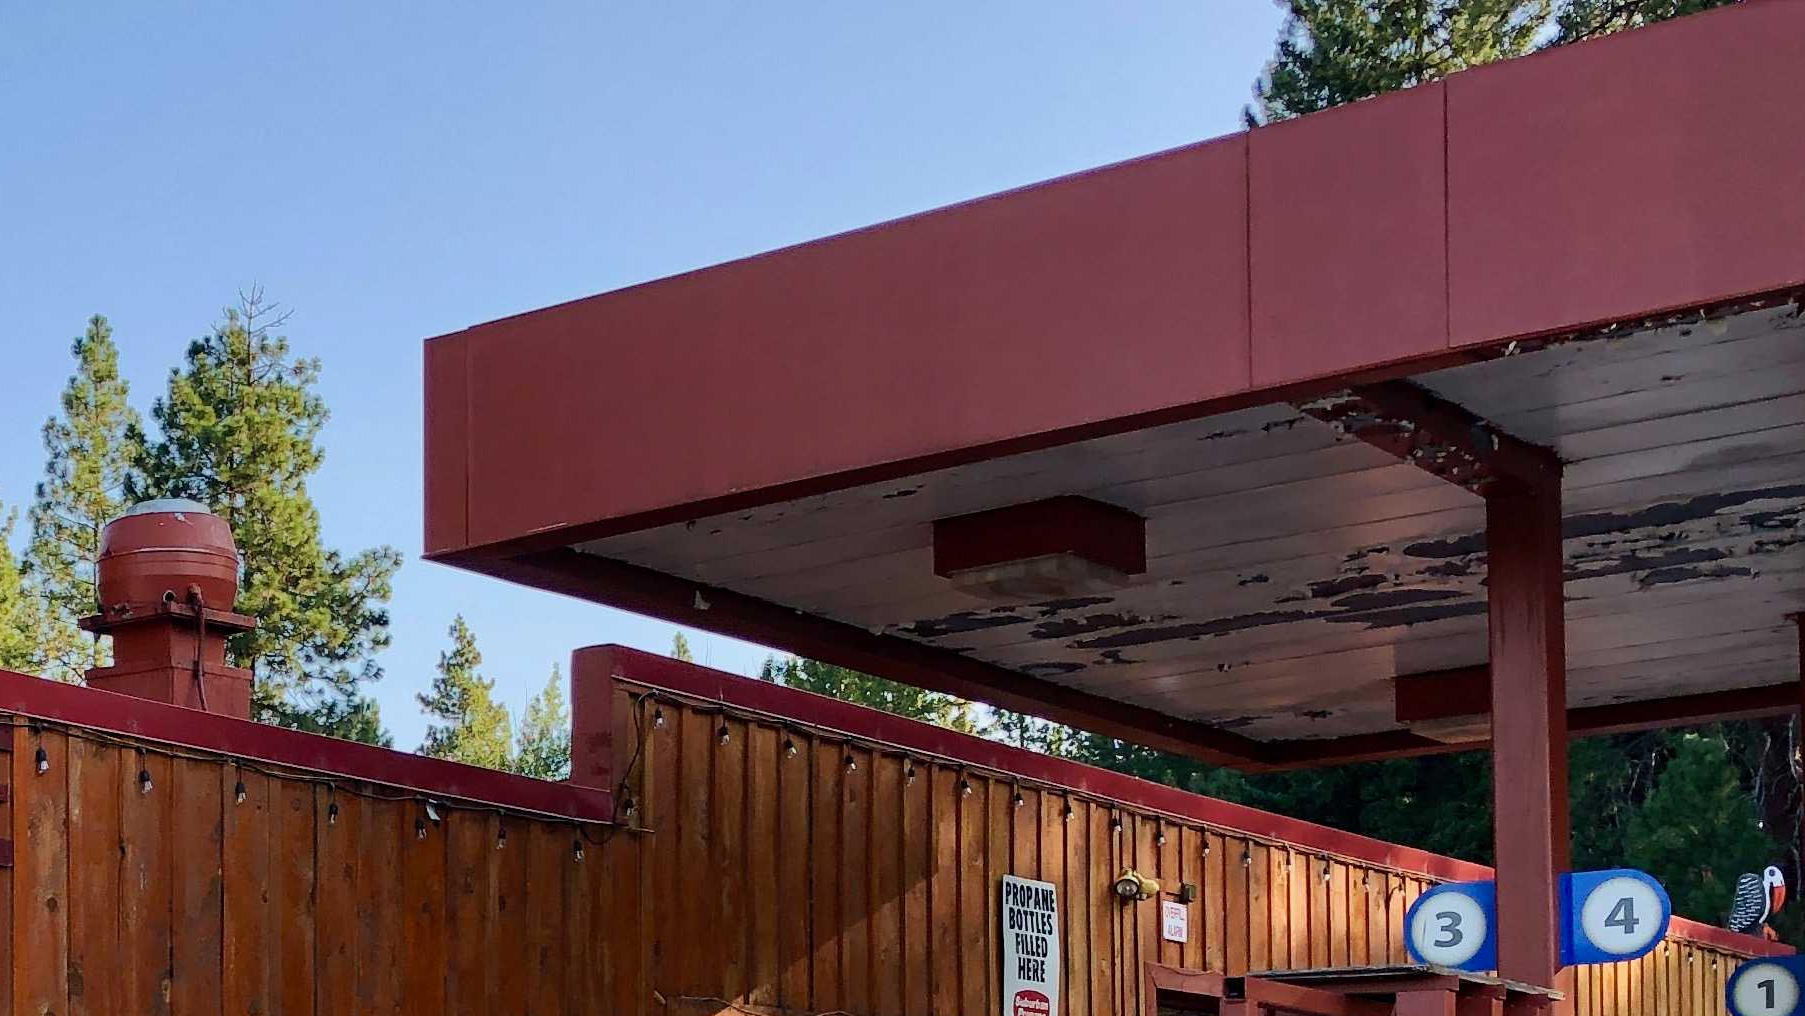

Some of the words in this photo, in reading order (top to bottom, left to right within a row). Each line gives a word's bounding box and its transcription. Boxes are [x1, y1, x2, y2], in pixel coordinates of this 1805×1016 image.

[1005, 881, 1055, 913] PROPANE
[1008, 907, 1053, 936] BOTTLES
[1433, 911, 1464, 948] 3
[1604, 897, 1640, 934] 4
[1015, 932, 1048, 958] FILLED
[1017, 957, 1046, 983] HERE
[1757, 979, 1776, 1009] 1
